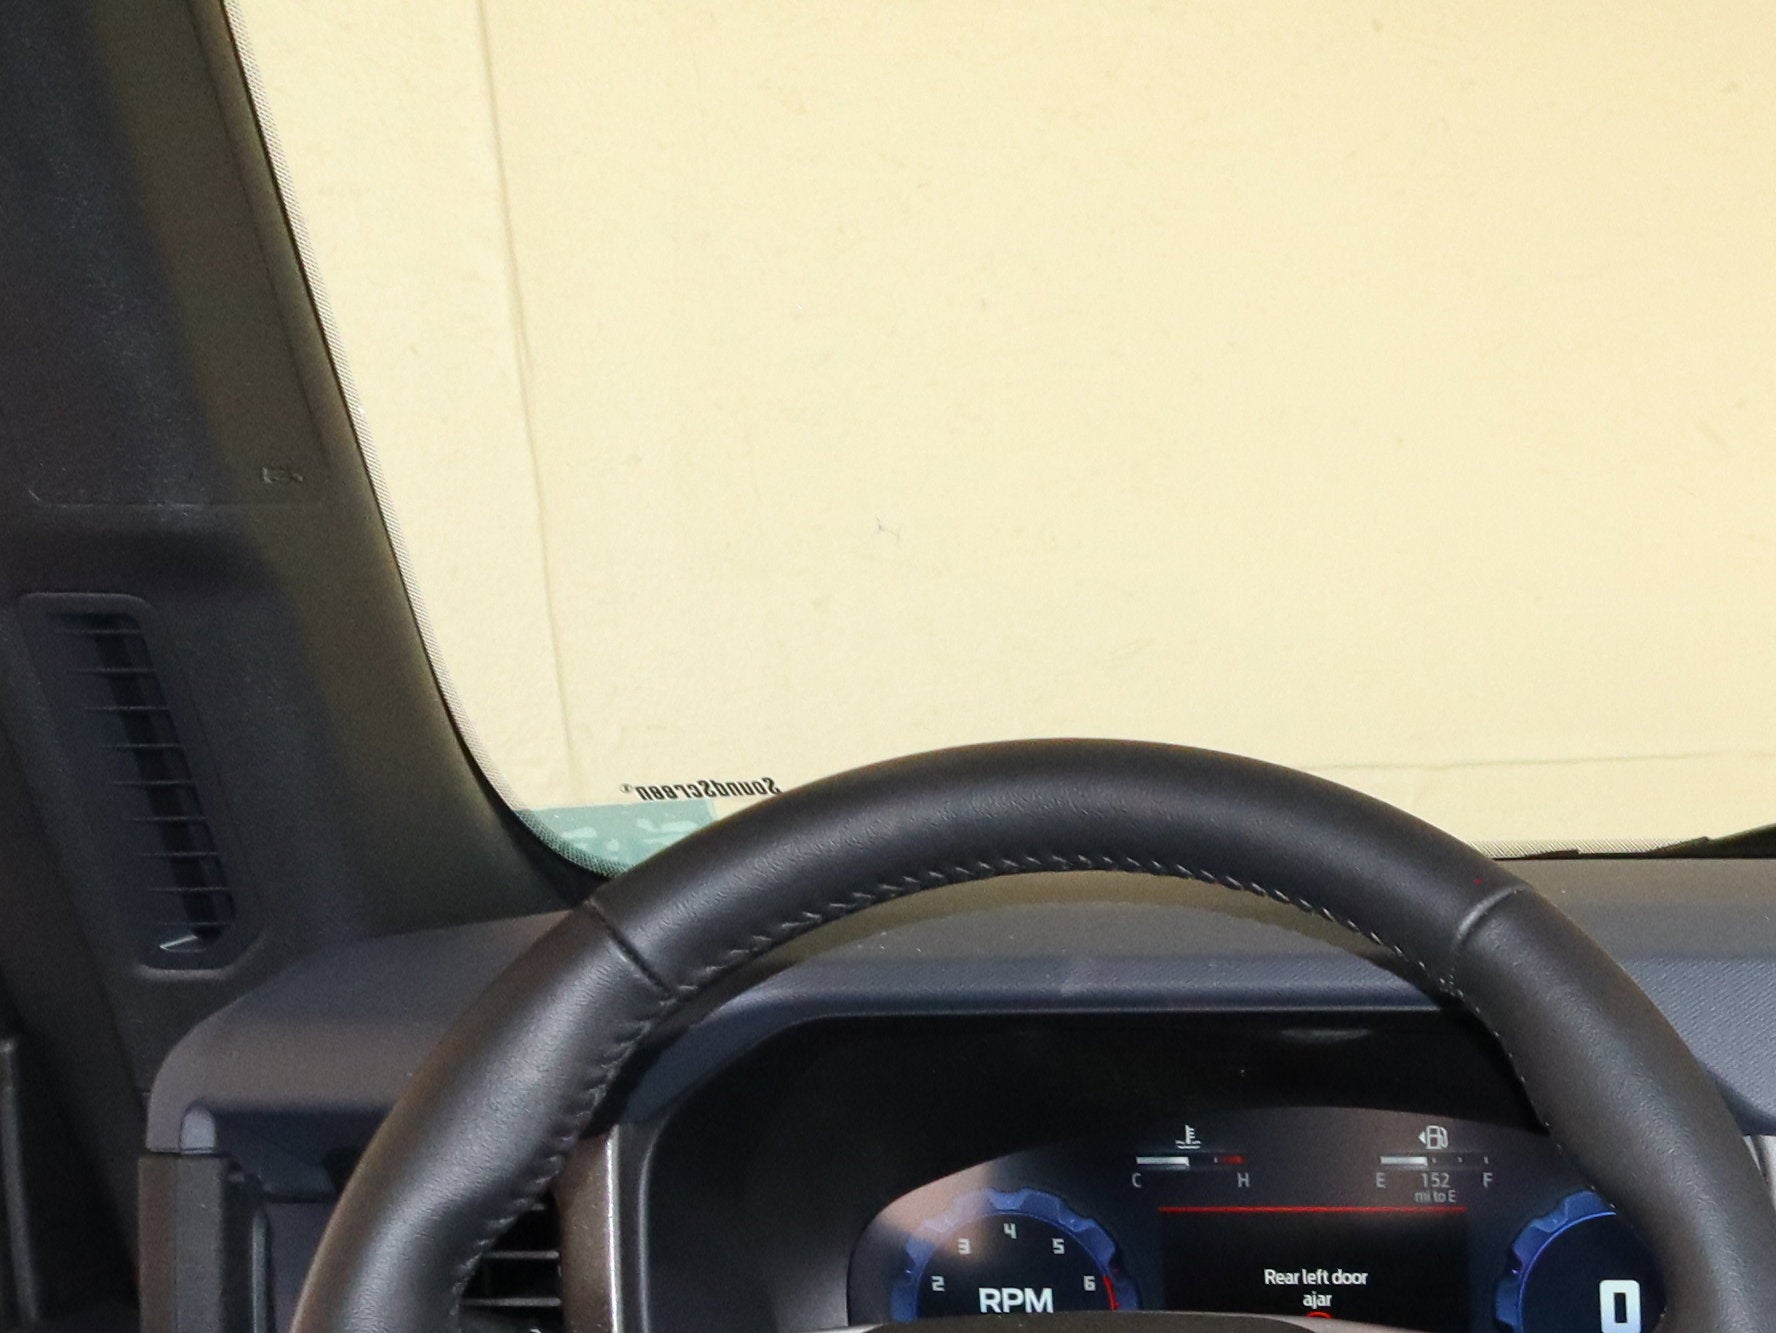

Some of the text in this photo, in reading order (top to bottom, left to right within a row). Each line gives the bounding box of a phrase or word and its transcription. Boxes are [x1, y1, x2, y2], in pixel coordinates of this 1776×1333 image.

[1131, 1173, 1141, 1187] C
[1237, 1173, 1250, 1187] H
[1376, 1173, 1386, 1187] E
[1421, 1173, 1450, 1187] 152
[1482, 1173, 1493, 1187] F
[1415, 1190, 1431, 1203] mi
[1432, 1190, 1447, 1203] to
[1003, 1223, 1017, 1239] 4
[958, 1239, 970, 1255] 3
[1052, 1239, 1064, 1255] 5
[931, 1276, 945, 1291] 2
[1084, 1276, 1096, 1290] 6
[1264, 1269, 1368, 1285] Rear left door
[979, 1288, 1054, 1313] RPM
[1303, 1290, 1333, 1310] ajar
